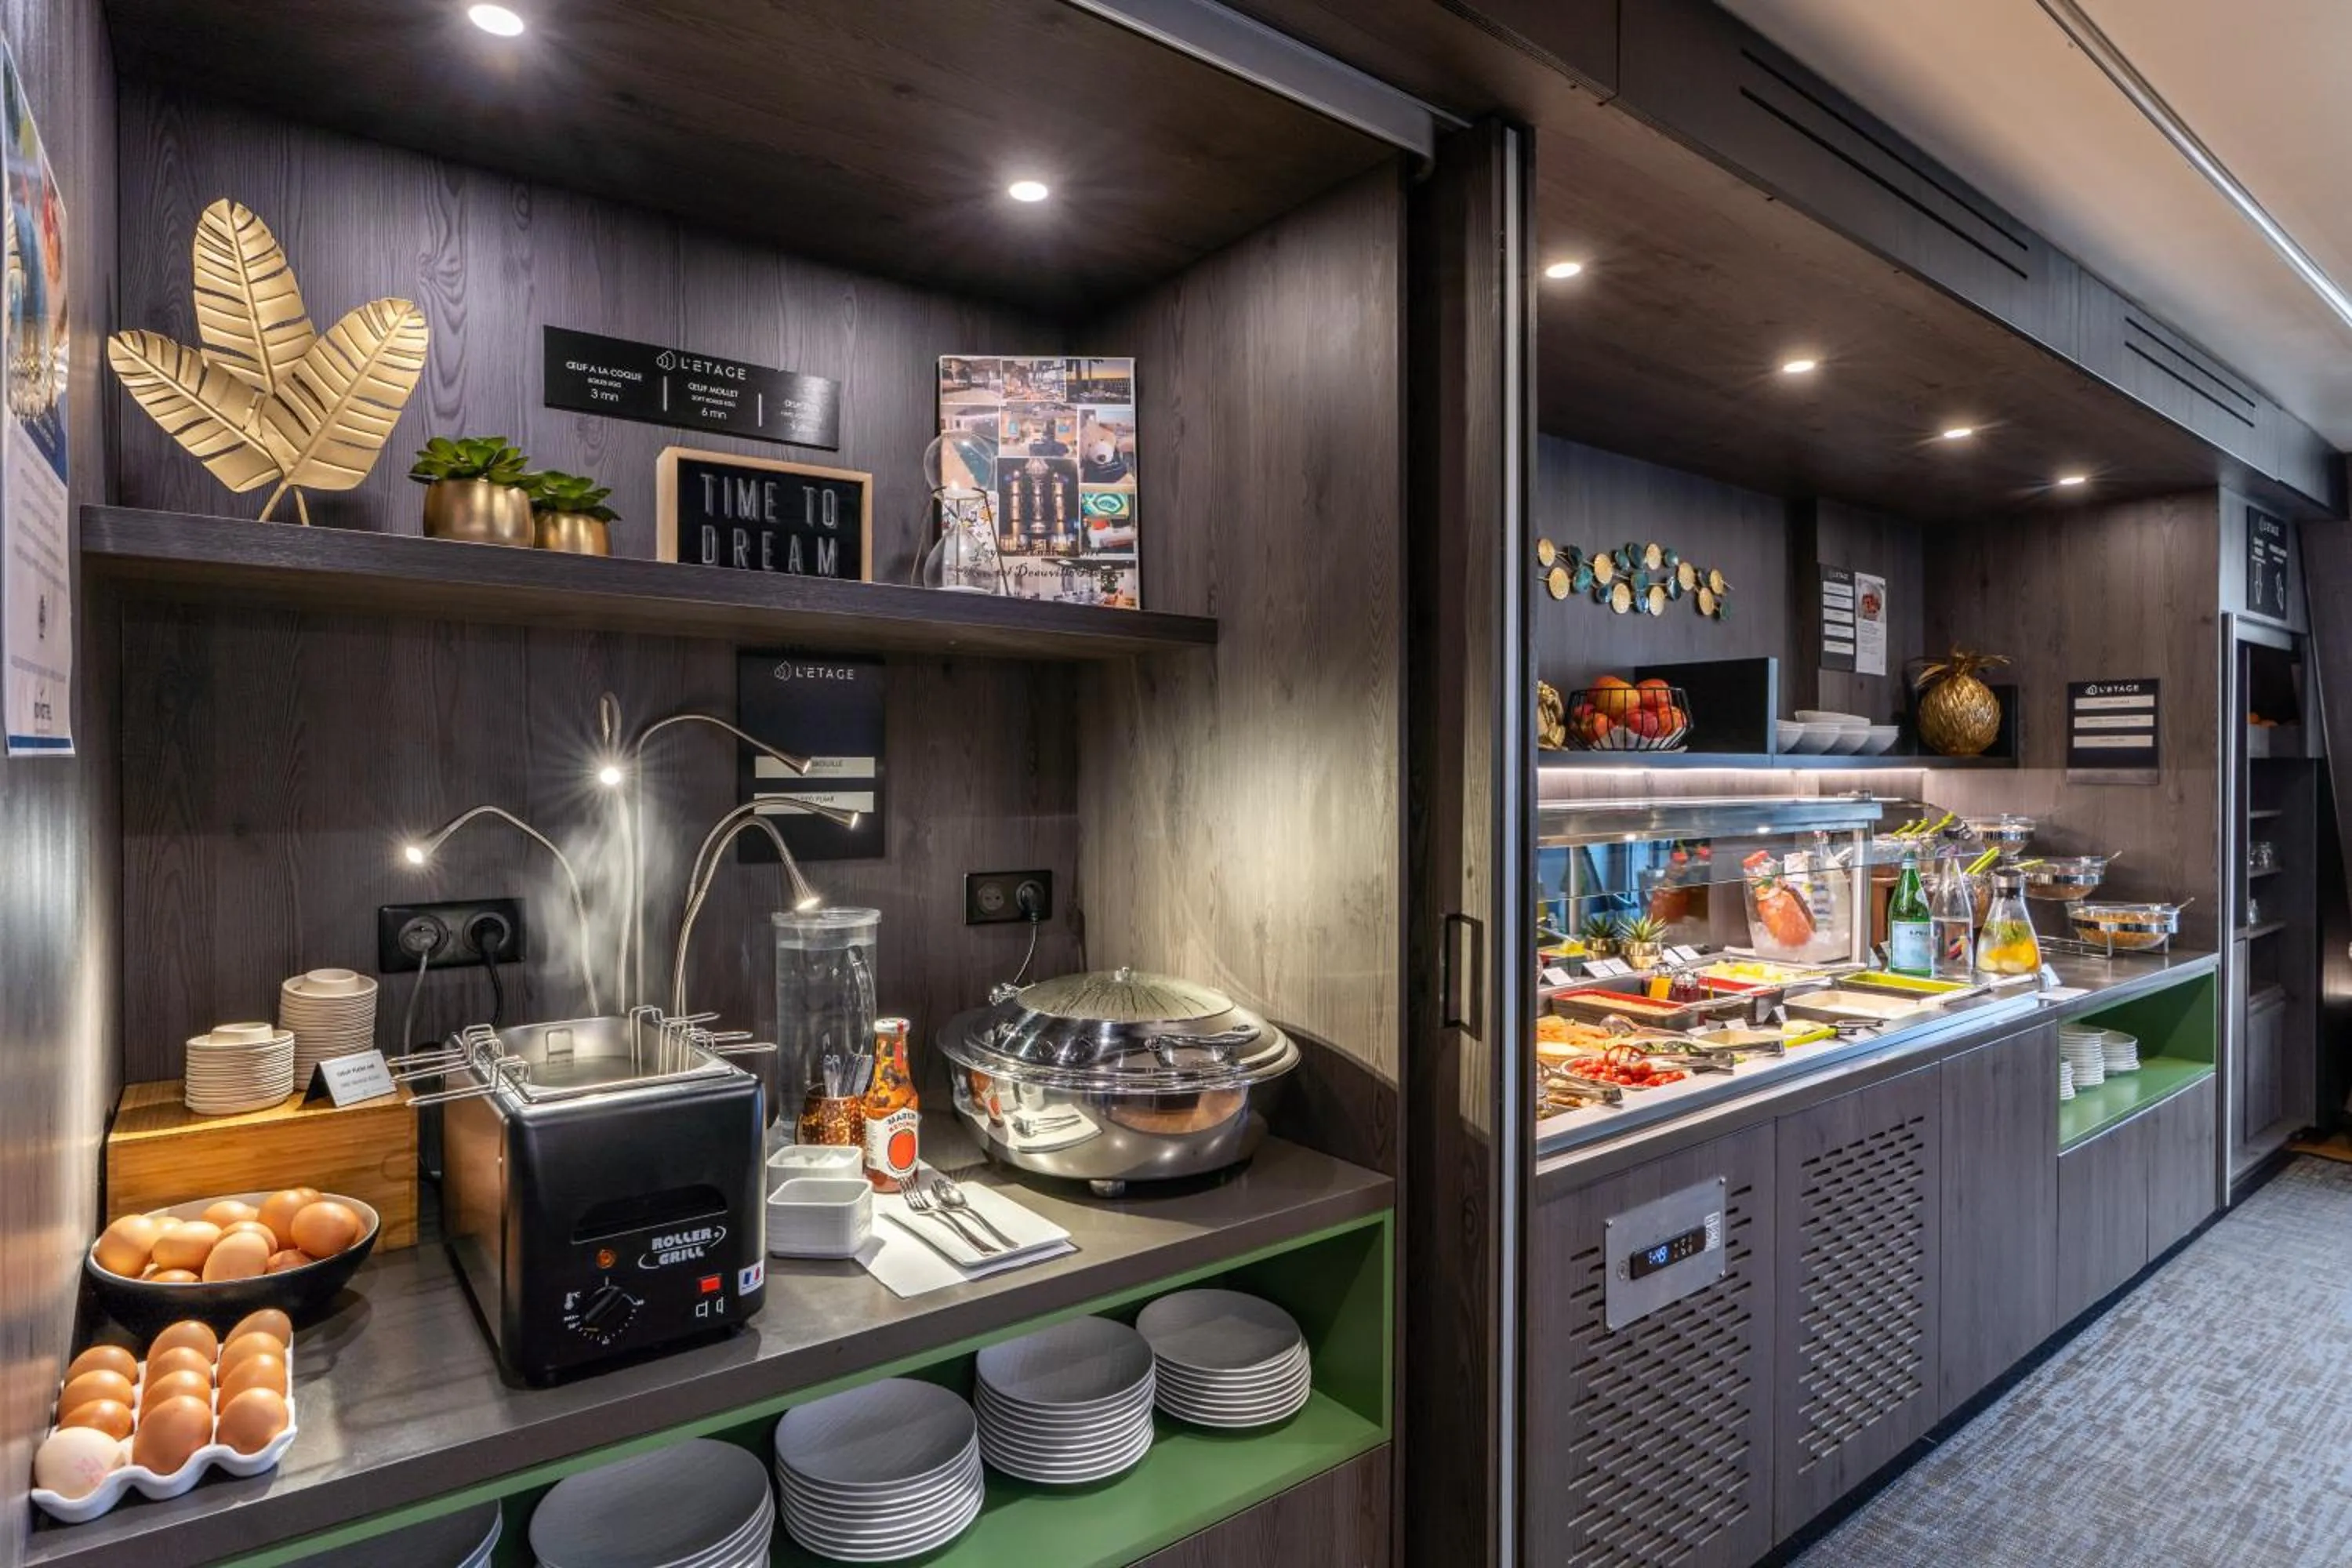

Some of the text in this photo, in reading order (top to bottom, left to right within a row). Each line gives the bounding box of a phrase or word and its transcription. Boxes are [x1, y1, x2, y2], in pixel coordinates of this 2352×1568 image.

[598, 366, 609, 376] LA
[610, 368, 642, 382] COQUE
[590, 388, 598, 399] 3
[702, 408, 708, 416] 6
[700, 473, 838, 529] TIME TO
[701, 524, 838, 576] DREAM
[652, 1227, 712, 1250] ROLLER
[659, 1246, 705, 1265] GRILL
